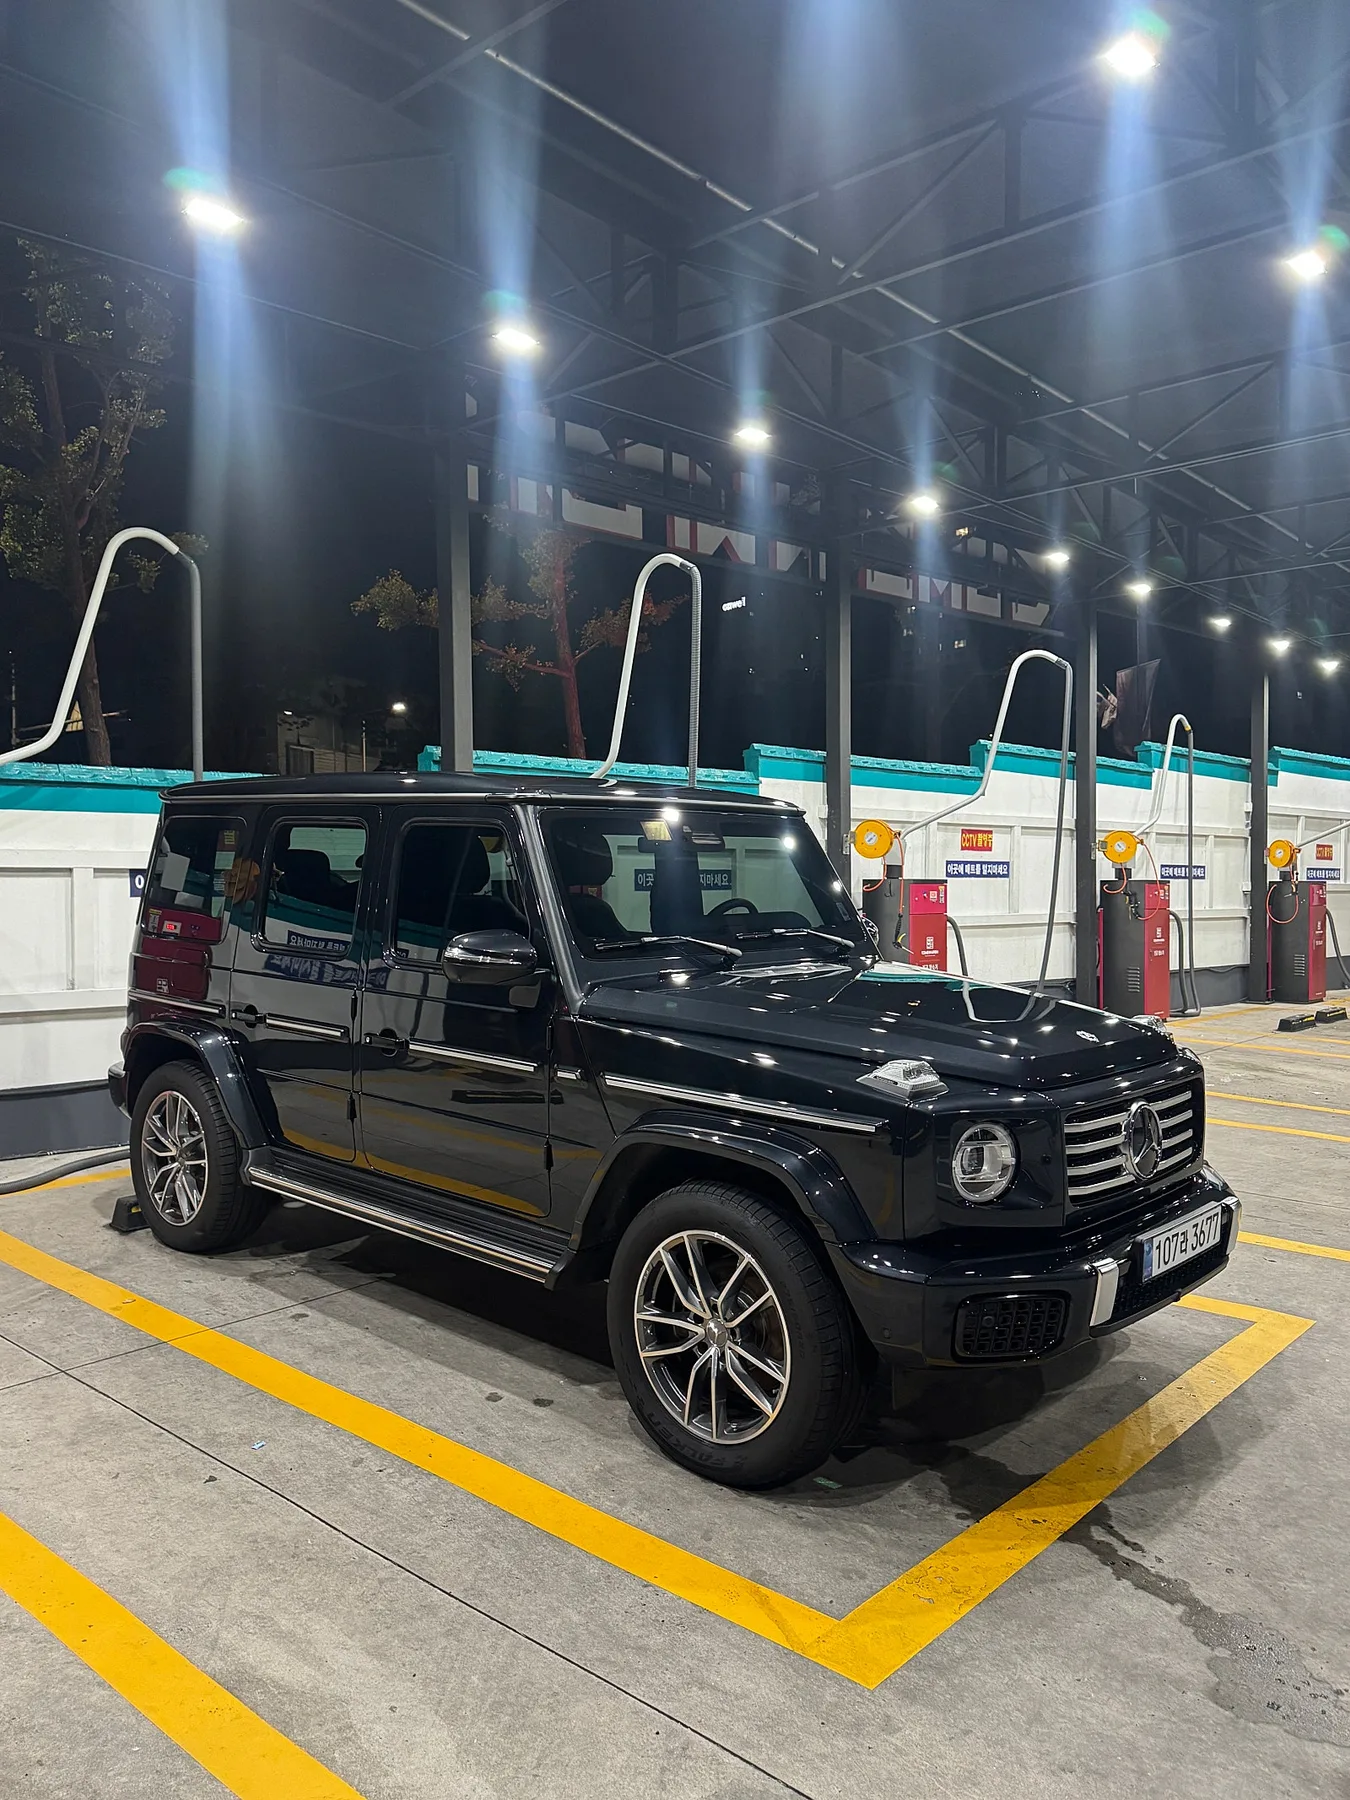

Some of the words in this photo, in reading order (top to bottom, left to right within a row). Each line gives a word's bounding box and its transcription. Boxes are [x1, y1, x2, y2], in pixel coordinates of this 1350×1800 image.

[962, 833, 977, 848] CCTV
[947, 863, 964, 875] 이곳에
[637, 873, 655, 887] 이곳
[1155, 1229, 1189, 1269] 107라
[1191, 1212, 1220, 1251] 3677
